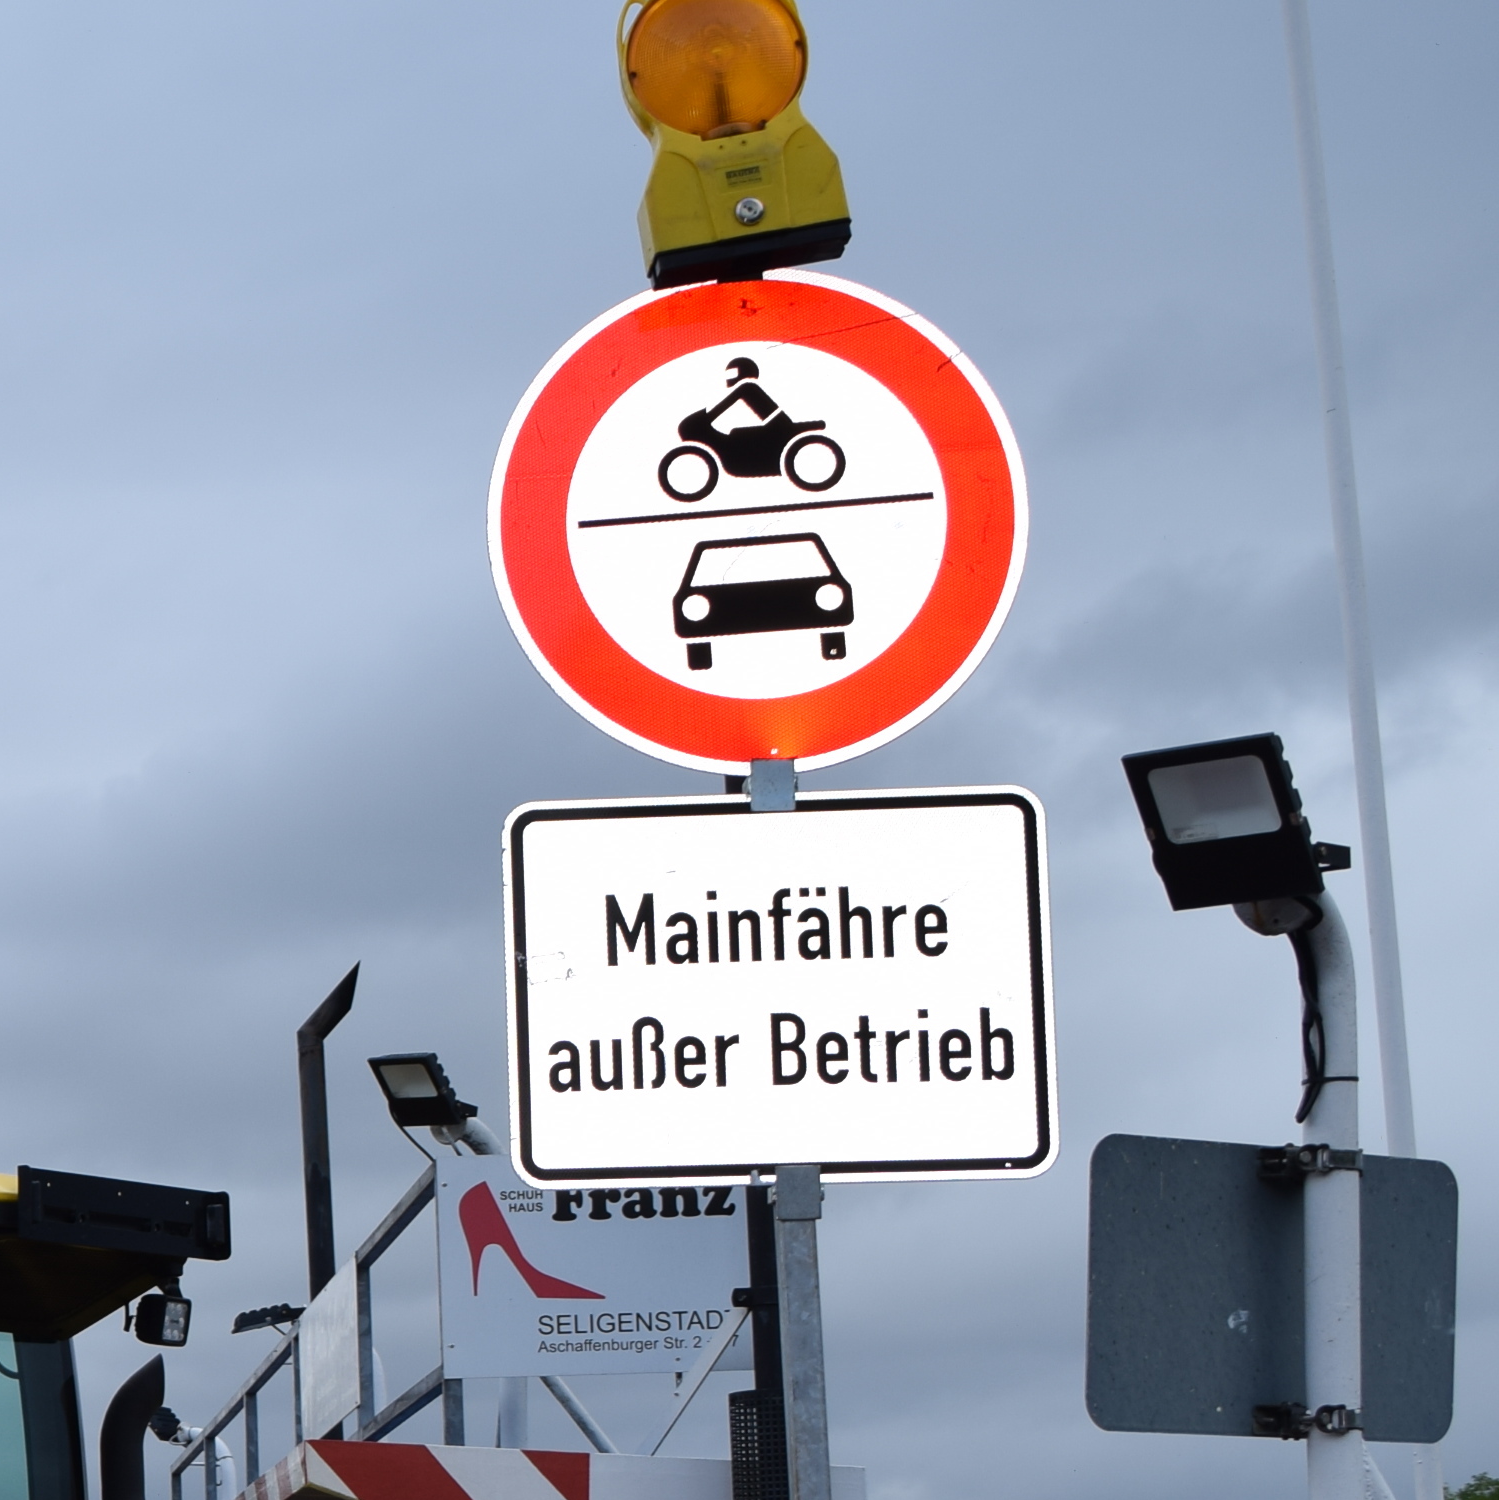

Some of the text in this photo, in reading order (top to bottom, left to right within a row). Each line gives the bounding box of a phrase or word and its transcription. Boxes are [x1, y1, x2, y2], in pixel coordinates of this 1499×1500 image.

[604, 886, 950, 967] Mainfähre
[547, 1007, 1016, 1092] außer Betrieb
[499, 1189, 544, 1202] SCHUH
[508, 1201, 544, 1213] HAUS
[551, 1186, 737, 1222] Franz
[538, 1309, 731, 1336] SELIGENSTAD
[537, 1338, 659, 1354] Aschaffenburger
[663, 1336, 688, 1350] Str.
